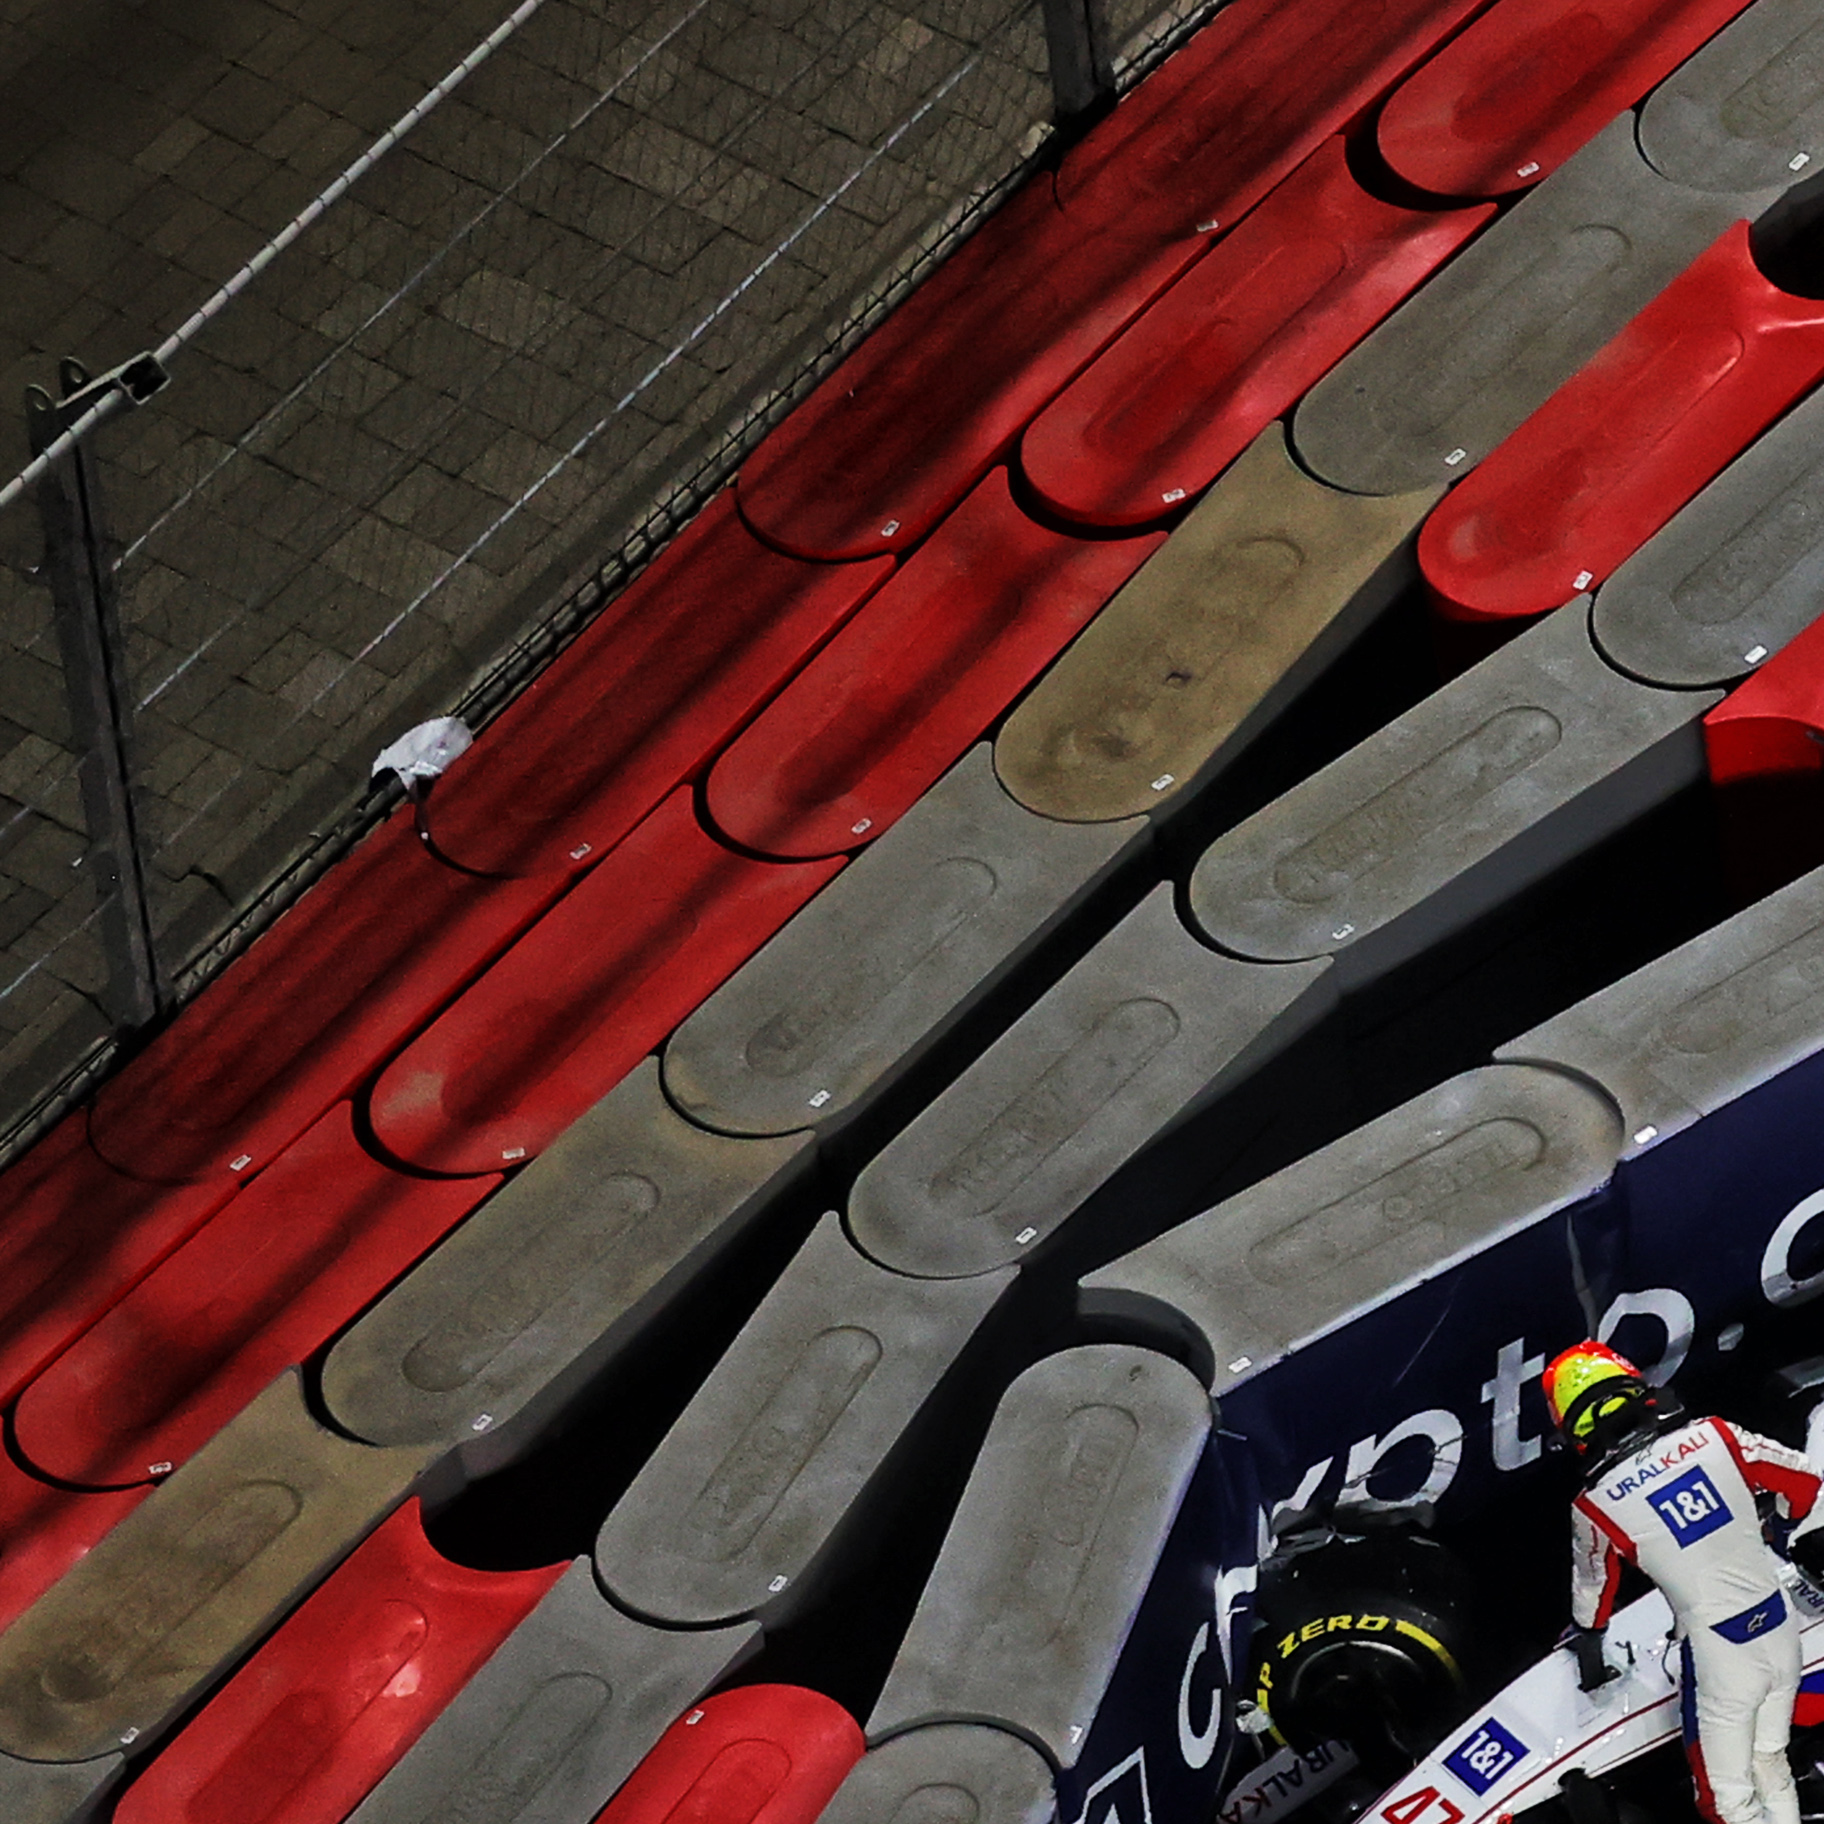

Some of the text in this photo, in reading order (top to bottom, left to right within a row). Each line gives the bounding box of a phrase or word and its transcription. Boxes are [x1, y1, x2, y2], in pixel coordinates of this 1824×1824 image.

[1606, 1433, 1710, 1501] URALKALI
[1658, 1480, 1721, 1531] 1&1
[1276, 1614, 1391, 1660] ZERO
[1459, 1730, 1511, 1776] 1&1
